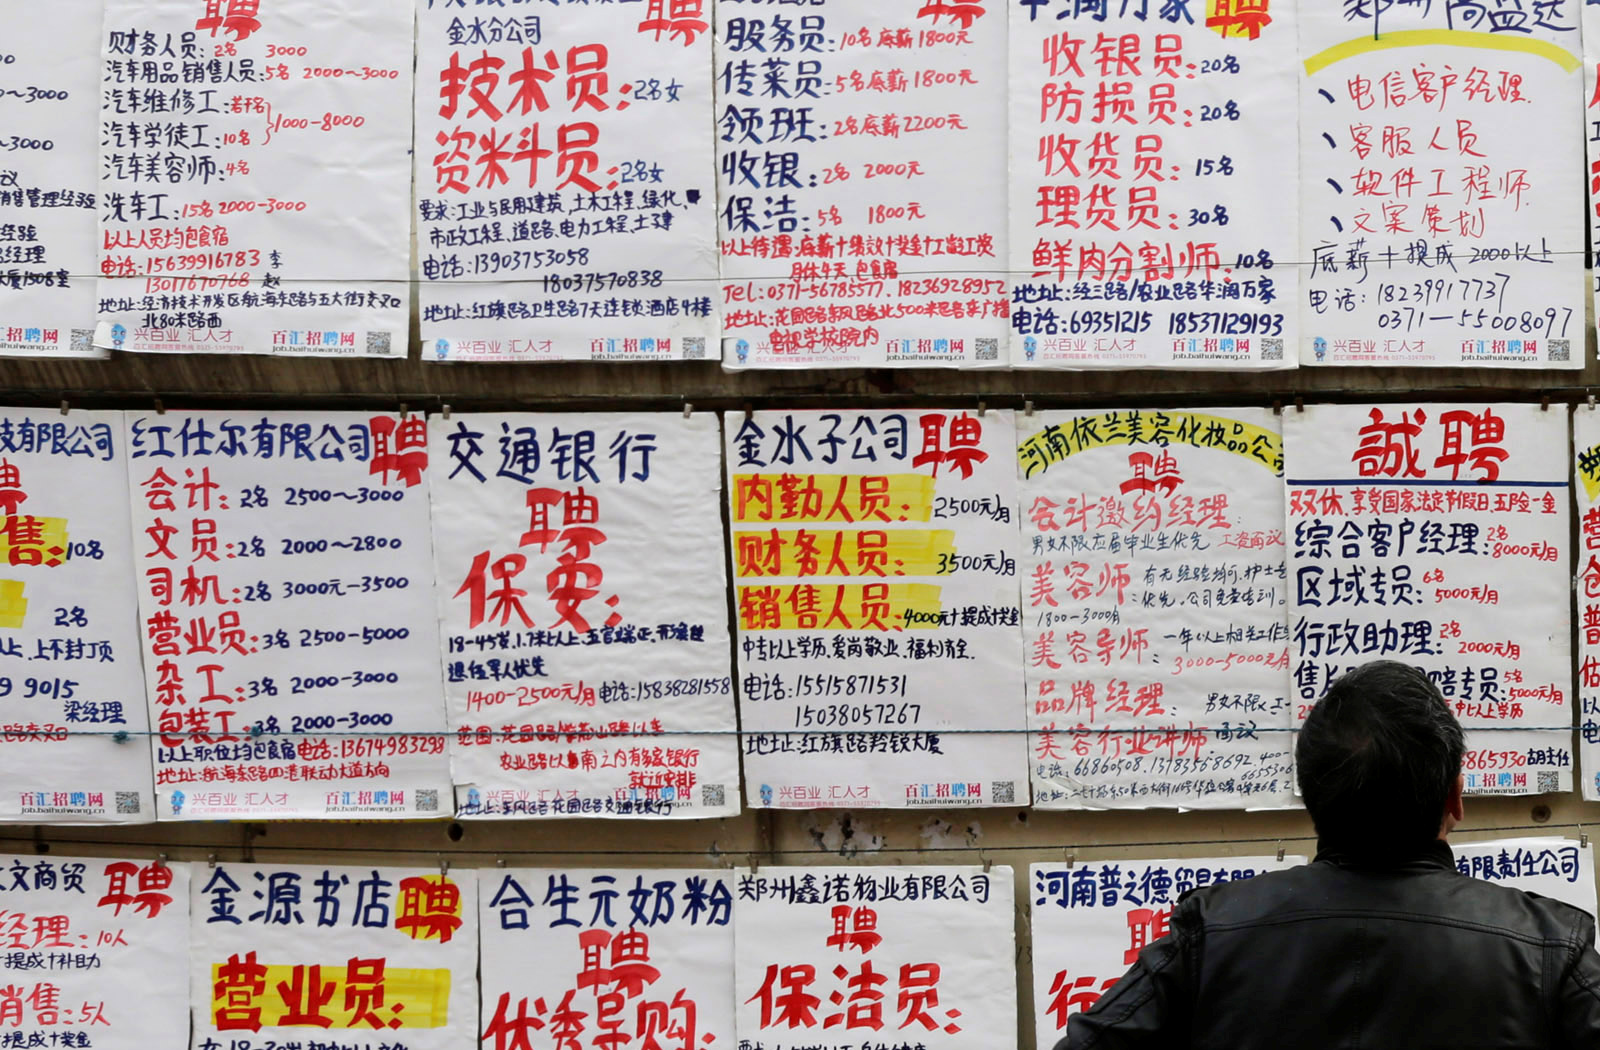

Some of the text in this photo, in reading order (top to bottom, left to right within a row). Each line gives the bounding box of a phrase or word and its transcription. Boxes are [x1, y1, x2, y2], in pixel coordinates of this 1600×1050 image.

[266, 44, 307, 57] 3000
[447, 16, 541, 46] 金水分公司
[1348, 121, 1488, 158] 客服人员
[1353, 204, 1485, 239] 文案策划
[1169, 312, 1284, 335] 18537129193
[131, 414, 428, 487] 红仕尔有限公司 聘
[446, 421, 657, 485] 交通银行
[912, 411, 989, 481] 聘
[518, 487, 606, 555] 聘
[795, 704, 921, 728] 15038057267
[201, 865, 464, 944] 金源书店 聘
[488, 874, 733, 929] 合生元奶粉
